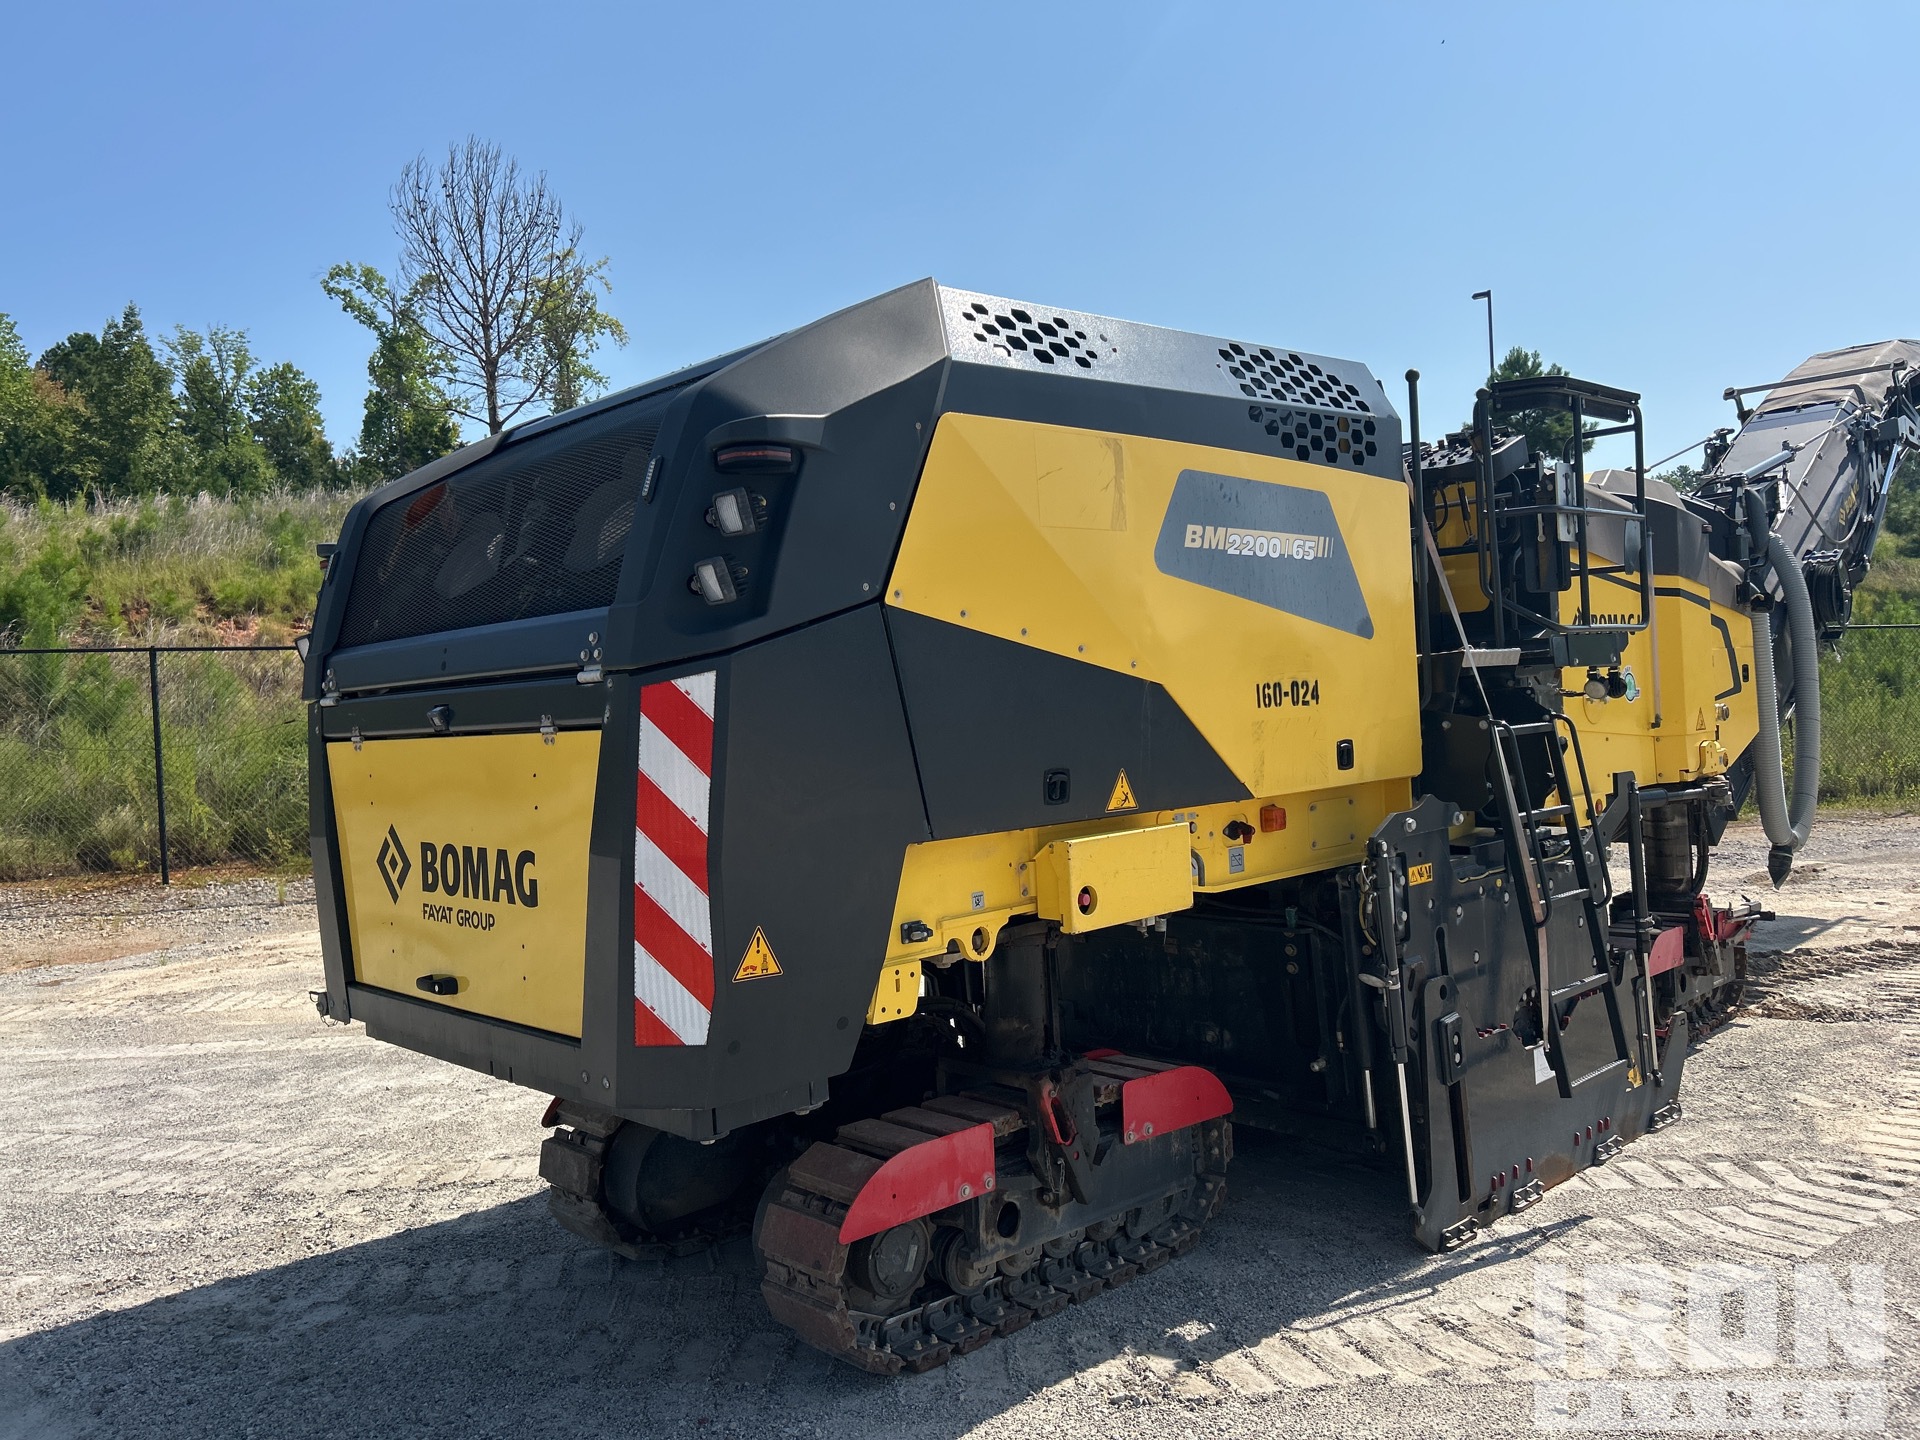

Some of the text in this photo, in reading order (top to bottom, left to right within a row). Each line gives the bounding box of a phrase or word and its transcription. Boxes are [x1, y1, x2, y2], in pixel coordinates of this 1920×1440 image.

[1256, 680, 1320, 708] 160-024
[420, 841, 539, 908] BOMAG
[422, 903, 496, 932] FAYAT GROUP
